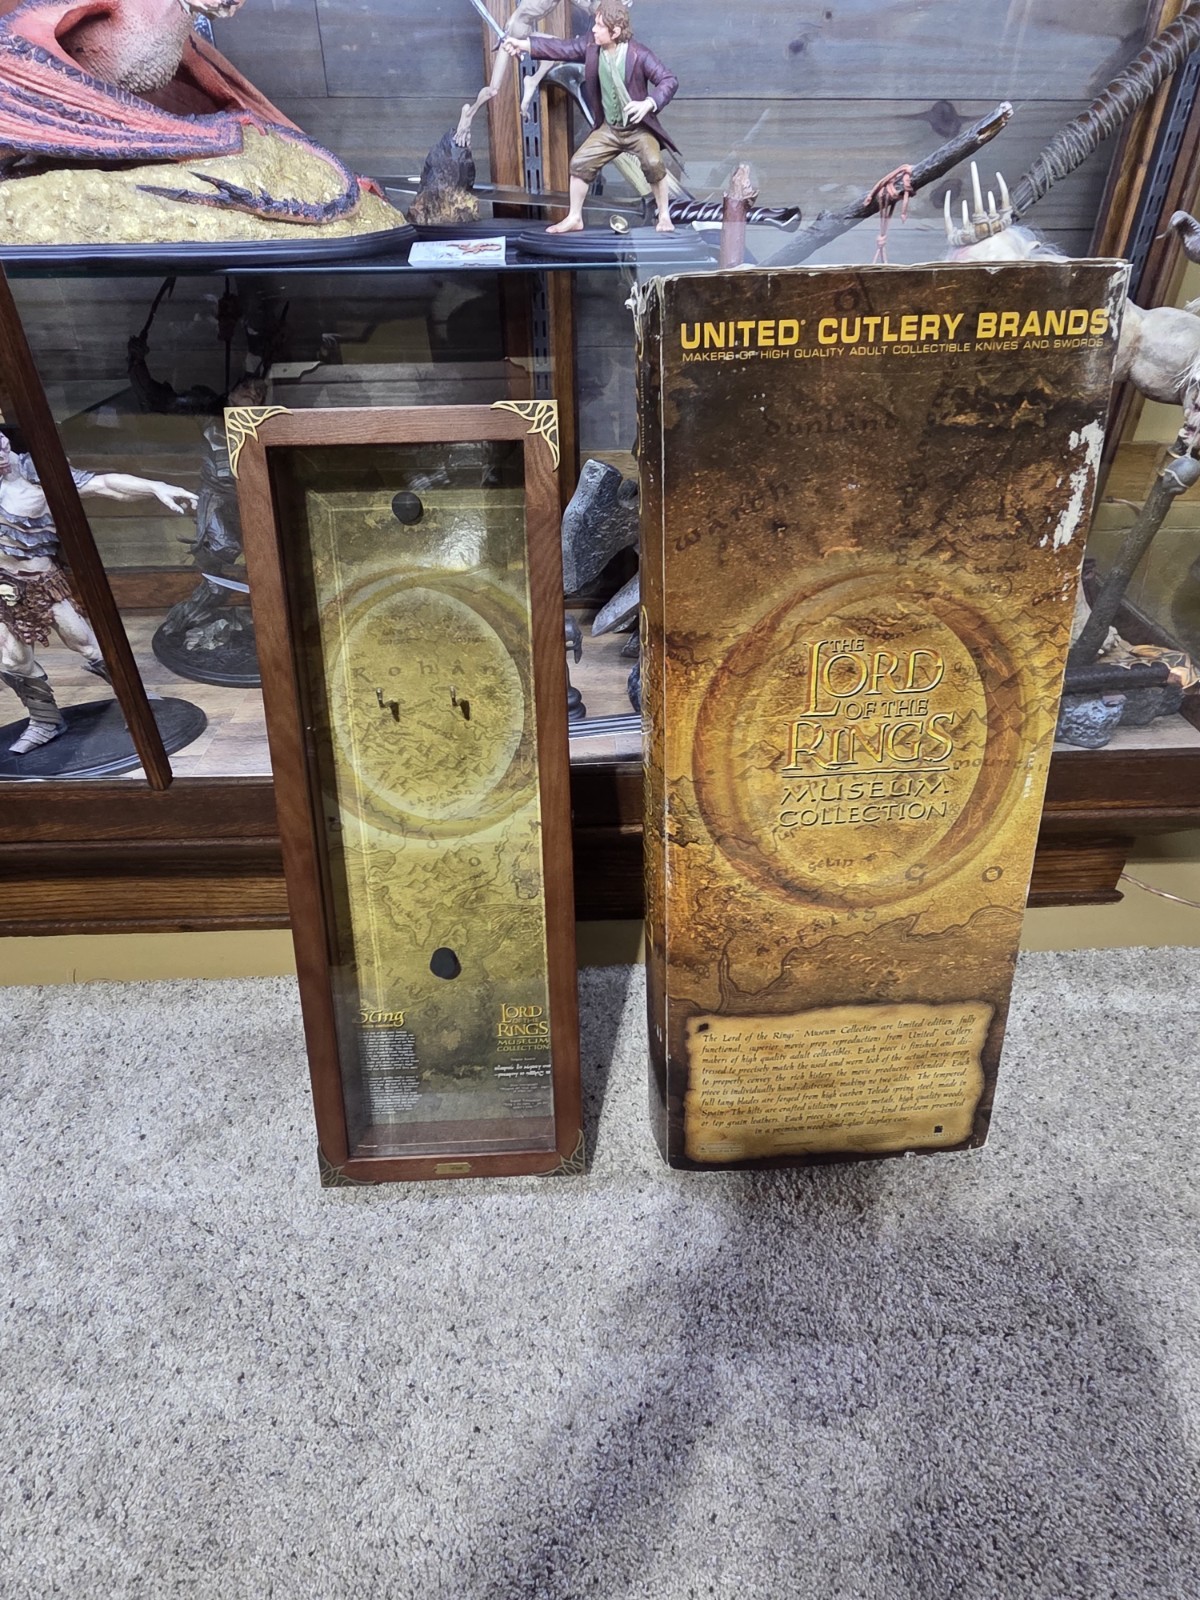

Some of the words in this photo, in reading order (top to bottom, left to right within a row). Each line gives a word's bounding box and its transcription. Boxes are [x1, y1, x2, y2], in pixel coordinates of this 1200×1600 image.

[680, 318, 800, 349] UNITED
[818, 313, 964, 345] CUTLERY
[976, 308, 1110, 339] BRANDS
[682, 351, 734, 362] MAKERS
[760, 349, 789, 359] HIGH
[794, 348, 844, 359] QUALITY
[850, 345, 888, 355] ADULT
[892, 342, 970, 355] COLLECTIBLE
[975, 340, 1018, 351] KNIVES
[1023, 339, 1049, 349] AND
[1053, 338, 1104, 349] SWORDS
[829, 639, 865, 653] THE
[799, 640, 945, 717] LORD
[843, 701, 877, 720] OF
[881, 699, 929, 718] THE
[781, 712, 956, 771] RINGS
[780, 777, 950, 805] MUSEUM
[778, 801, 947, 827] COLLECTION
[354, 1008, 406, 1028] Sting
[500, 1003, 542, 1023] LORD
[497, 1021, 549, 1037] RINGS
[702, 1033, 717, 1042] The
[722, 1033, 742, 1042] Lord
[745, 1032, 754, 1044] of
[757, 1032, 768, 1041] the
[803, 1029, 836, 1038] Museum
[840, 1024, 877, 1034] Collection
[957, 1014, 976, 1027] fully
[496, 1044, 551, 1052] COLLECTION
[702, 1055, 727, 1063] makers
[730, 1055, 740, 1066] of
[741, 1053, 757, 1065] high
[760, 1053, 787, 1065] quality
[789, 1050, 811, 1060] adult
[857, 1044, 876, 1055] Each
[878, 1045, 898, 1054] piece
[900, 1043, 906, 1051] is
[908, 1039, 939, 1052] finished
[940, 1037, 956, 1047] and
[749, 1044, 779, 1053] superior
[783, 1042, 805, 1050] movie
[809, 1041, 828, 1052] prop
[832, 1035, 881, 1046] reproductions
[885, 1032, 903, 1044] from
[702, 1065, 727, 1075] tressed
[736, 1064, 770, 1076] precisely
[771, 1062, 795, 1071] match
[797, 1061, 809, 1070] the
[810, 1059, 828, 1069] used
[828, 1057, 845, 1067] and
[865, 1054, 880, 1064] look
[881, 1054, 890, 1065] of
[891, 1052, 903, 1062] the
[904, 1050, 929, 1061] actual
[702, 1077, 710, 1086] to
[711, 1076, 744, 1088] properly
[746, 1077, 772, 1086] convey
[775, 1073, 786, 1082] the
[790, 1072, 805, 1080] rich
[808, 1071, 833, 1080] history
[836, 1068, 848, 1077] the
[851, 1068, 872, 1076] movie
[874, 1064, 910, 1075] producers
[951, 1057, 970, 1067] Each
[700, 1089, 721, 1099] piece
[730, 1085, 776, 1095] individually
[840, 1078, 866, 1087] making
[878, 1076, 891, 1084] two
[917, 1071, 931, 1080] The
[701, 1098, 716, 1108] full
[717, 1098, 734, 1108] tang
[737, 1096, 760, 1106] blades
[774, 1092, 801, 1105] forged
[801, 1093, 819, 1103] from
[821, 1089, 837, 1101] high
[839, 1088, 864, 1098] carbon
[867, 1086, 891, 1095] Toledo
[892, 1085, 915, 1094] spring
[938, 1078, 958, 1088] made
